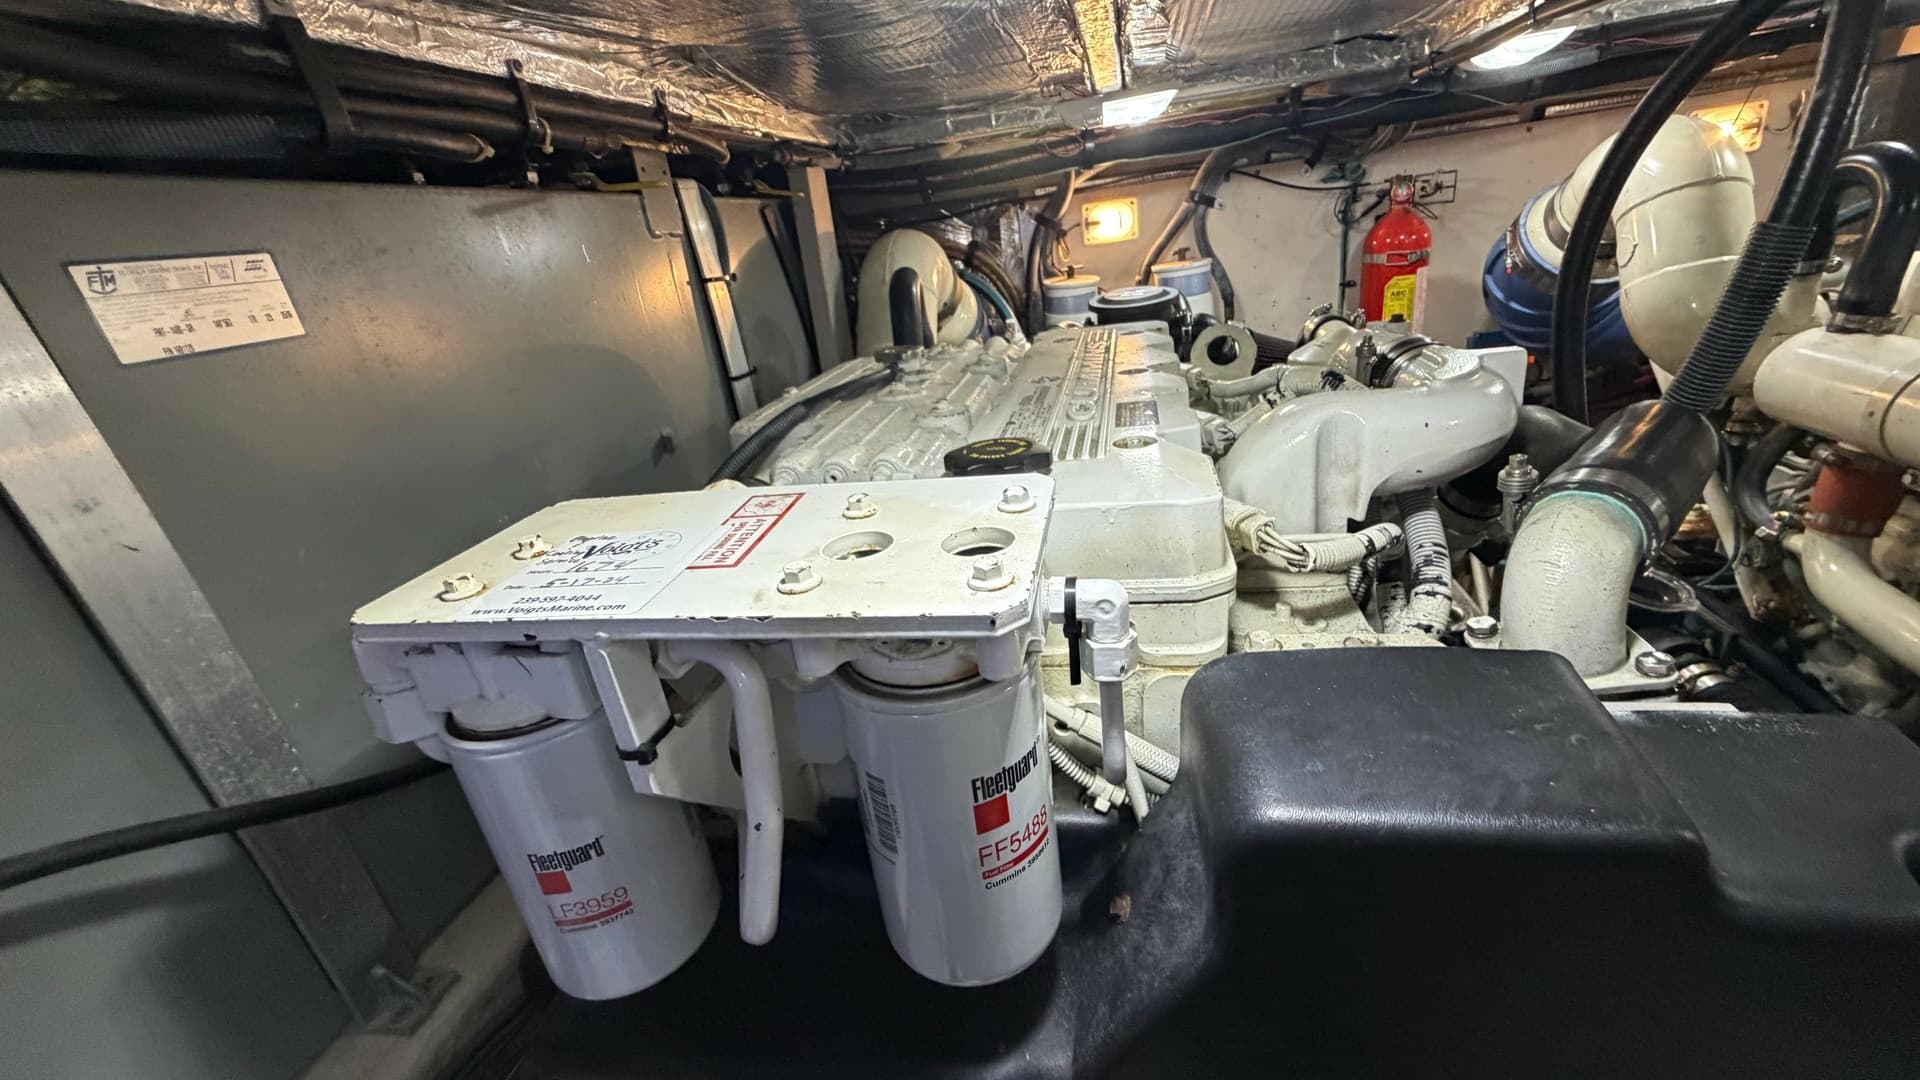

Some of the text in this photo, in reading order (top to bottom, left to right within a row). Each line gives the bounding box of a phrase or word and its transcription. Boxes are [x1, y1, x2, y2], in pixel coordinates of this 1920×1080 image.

[713, 518, 767, 563] ATTENTION
[471, 603, 626, 616] www.VoigtsMarine.com
[971, 740, 1038, 803] Fleetguard
[978, 804, 1047, 867] FF5488
[527, 836, 605, 872] Fleetguard
[985, 866, 1027, 890] Cummins
[548, 886, 628, 919] LF3959
